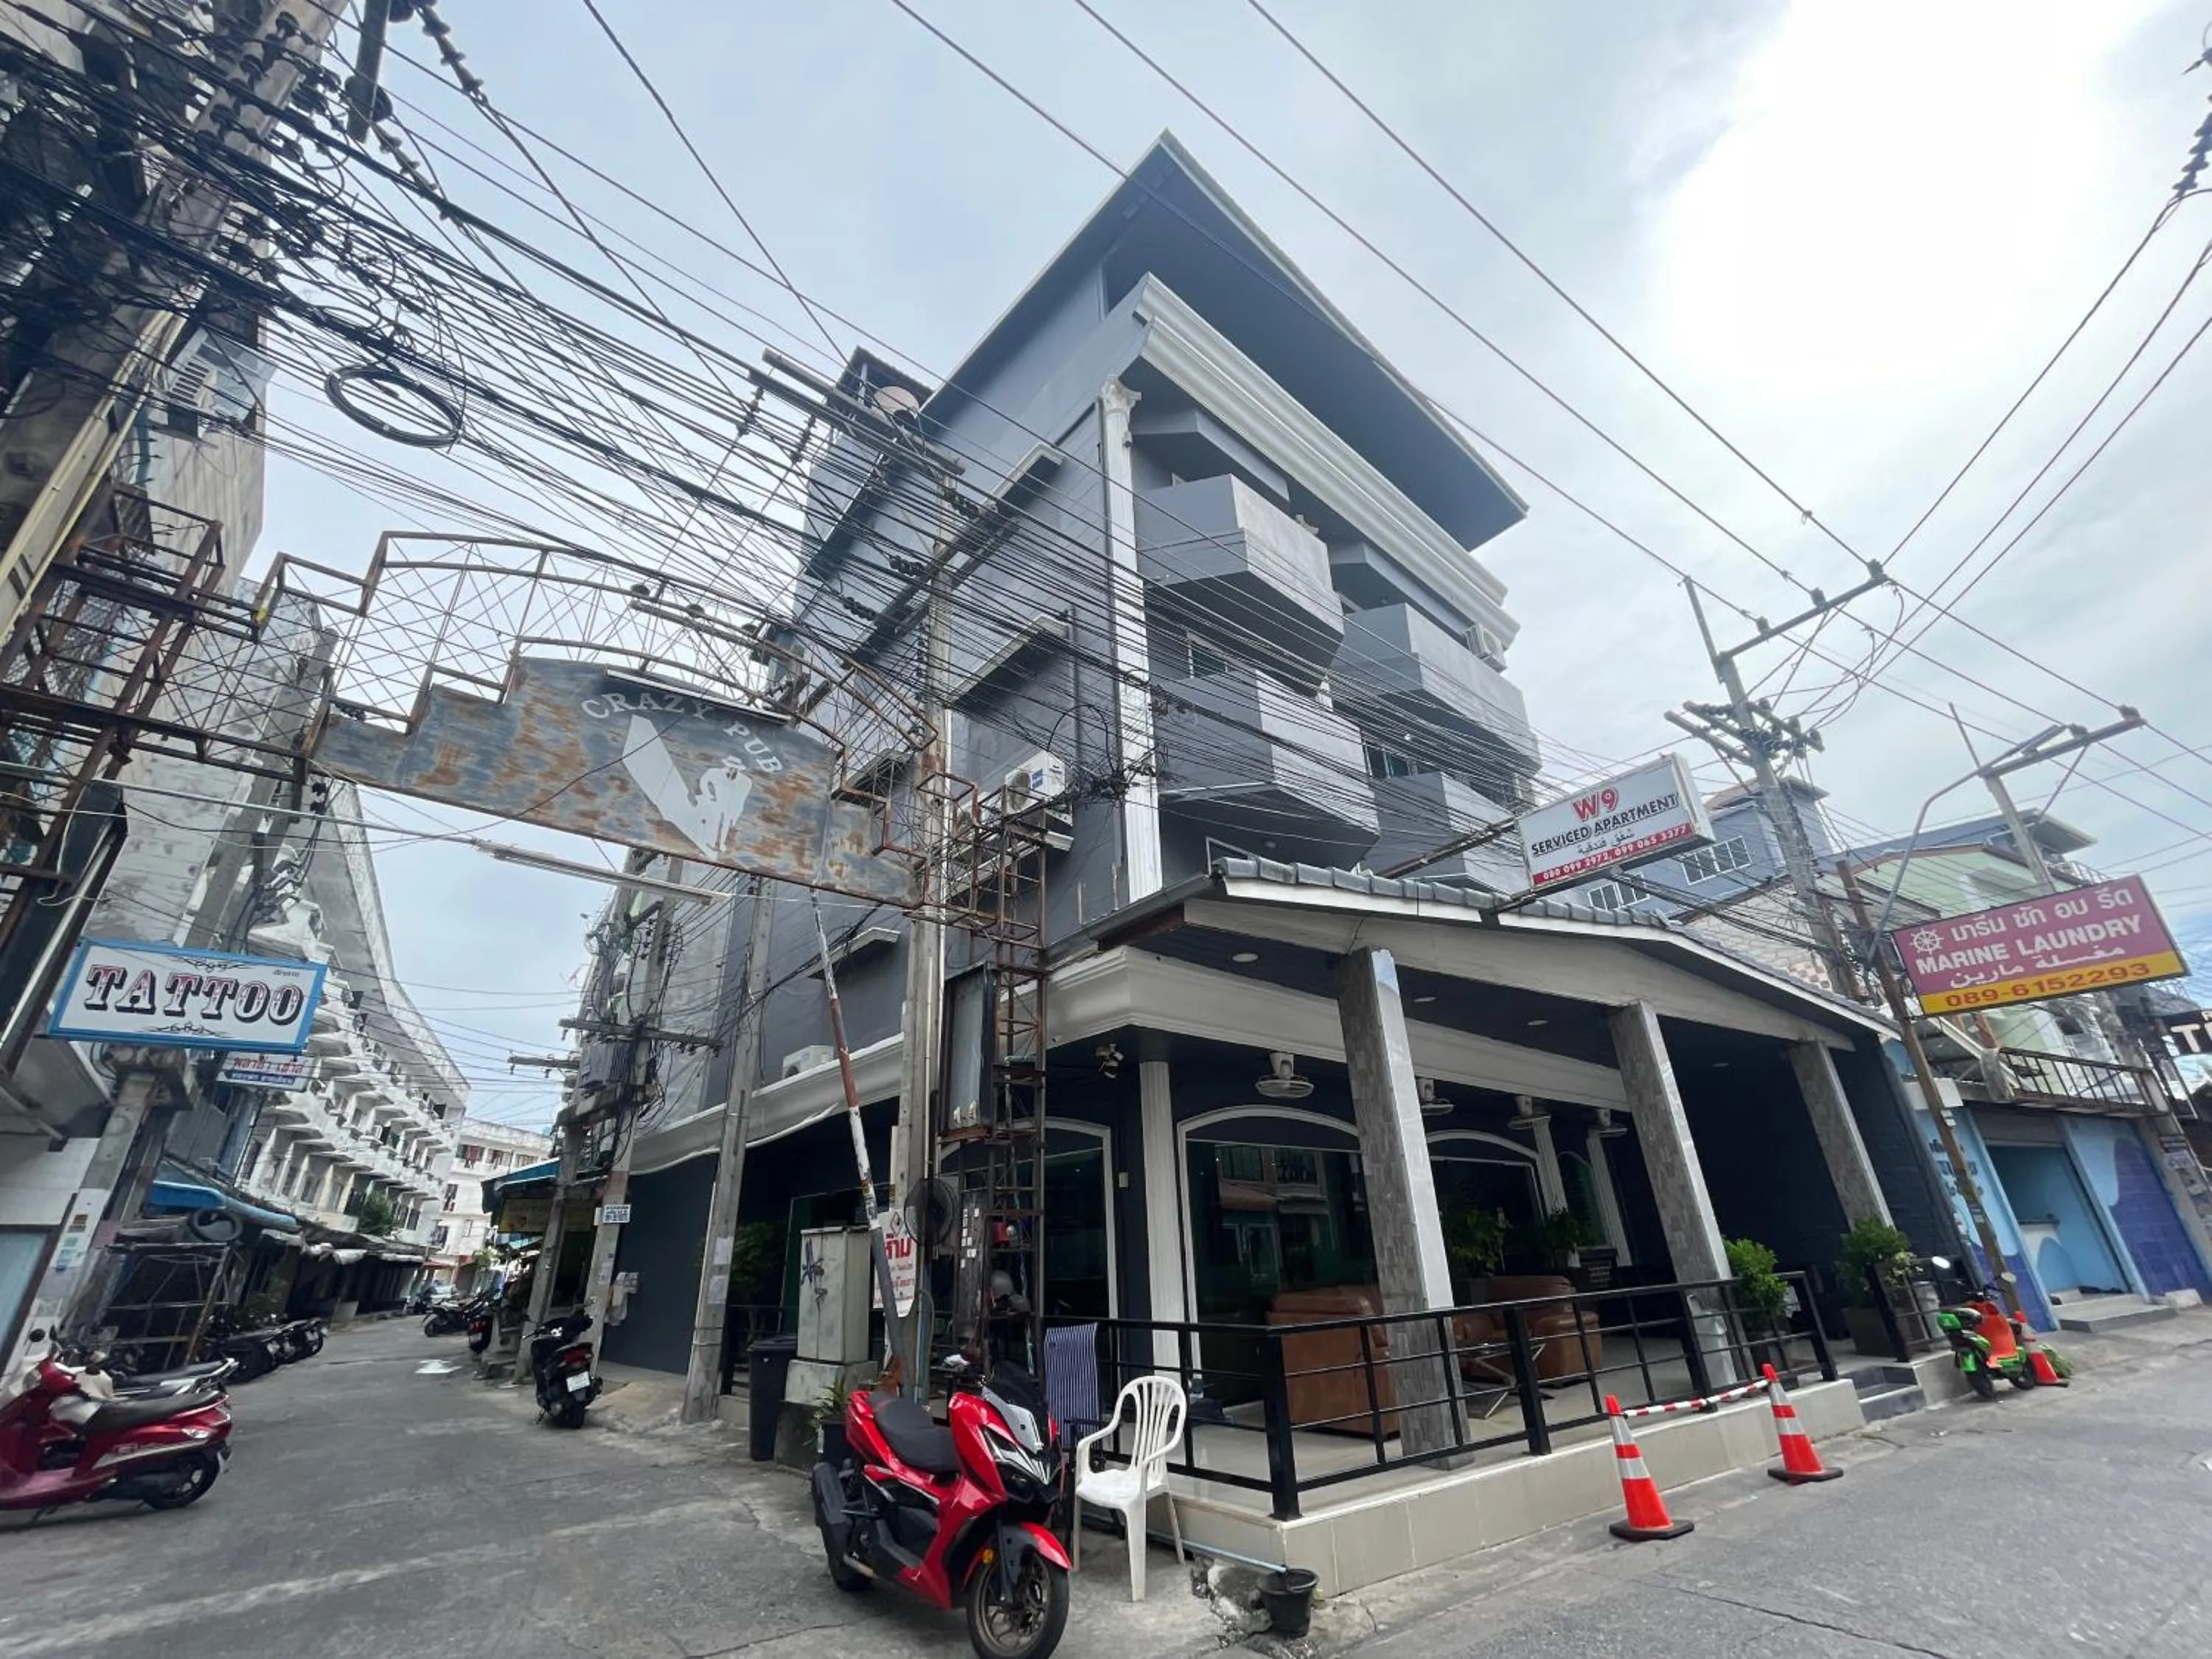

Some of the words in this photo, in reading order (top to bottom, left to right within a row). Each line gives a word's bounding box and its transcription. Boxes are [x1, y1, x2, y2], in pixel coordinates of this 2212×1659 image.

[582, 692, 715, 720] CRAZY
[723, 720, 783, 773] PUB
[1531, 825, 1592, 858] SERVICED
[1595, 792, 1679, 836] APARTMENT
[1571, 787, 1618, 822] W9
[2054, 897, 2090, 919] อบ
[1916, 943, 2011, 975] MARINE
[2015, 914, 2142, 956] LAUNDRY
[2035, 945, 2126, 970] مغسلة
[83, 964, 305, 1026] TATTOO
[1946, 962, 2151, 1007] 089-6152293
[1950, 963, 2025, 989] مارين
